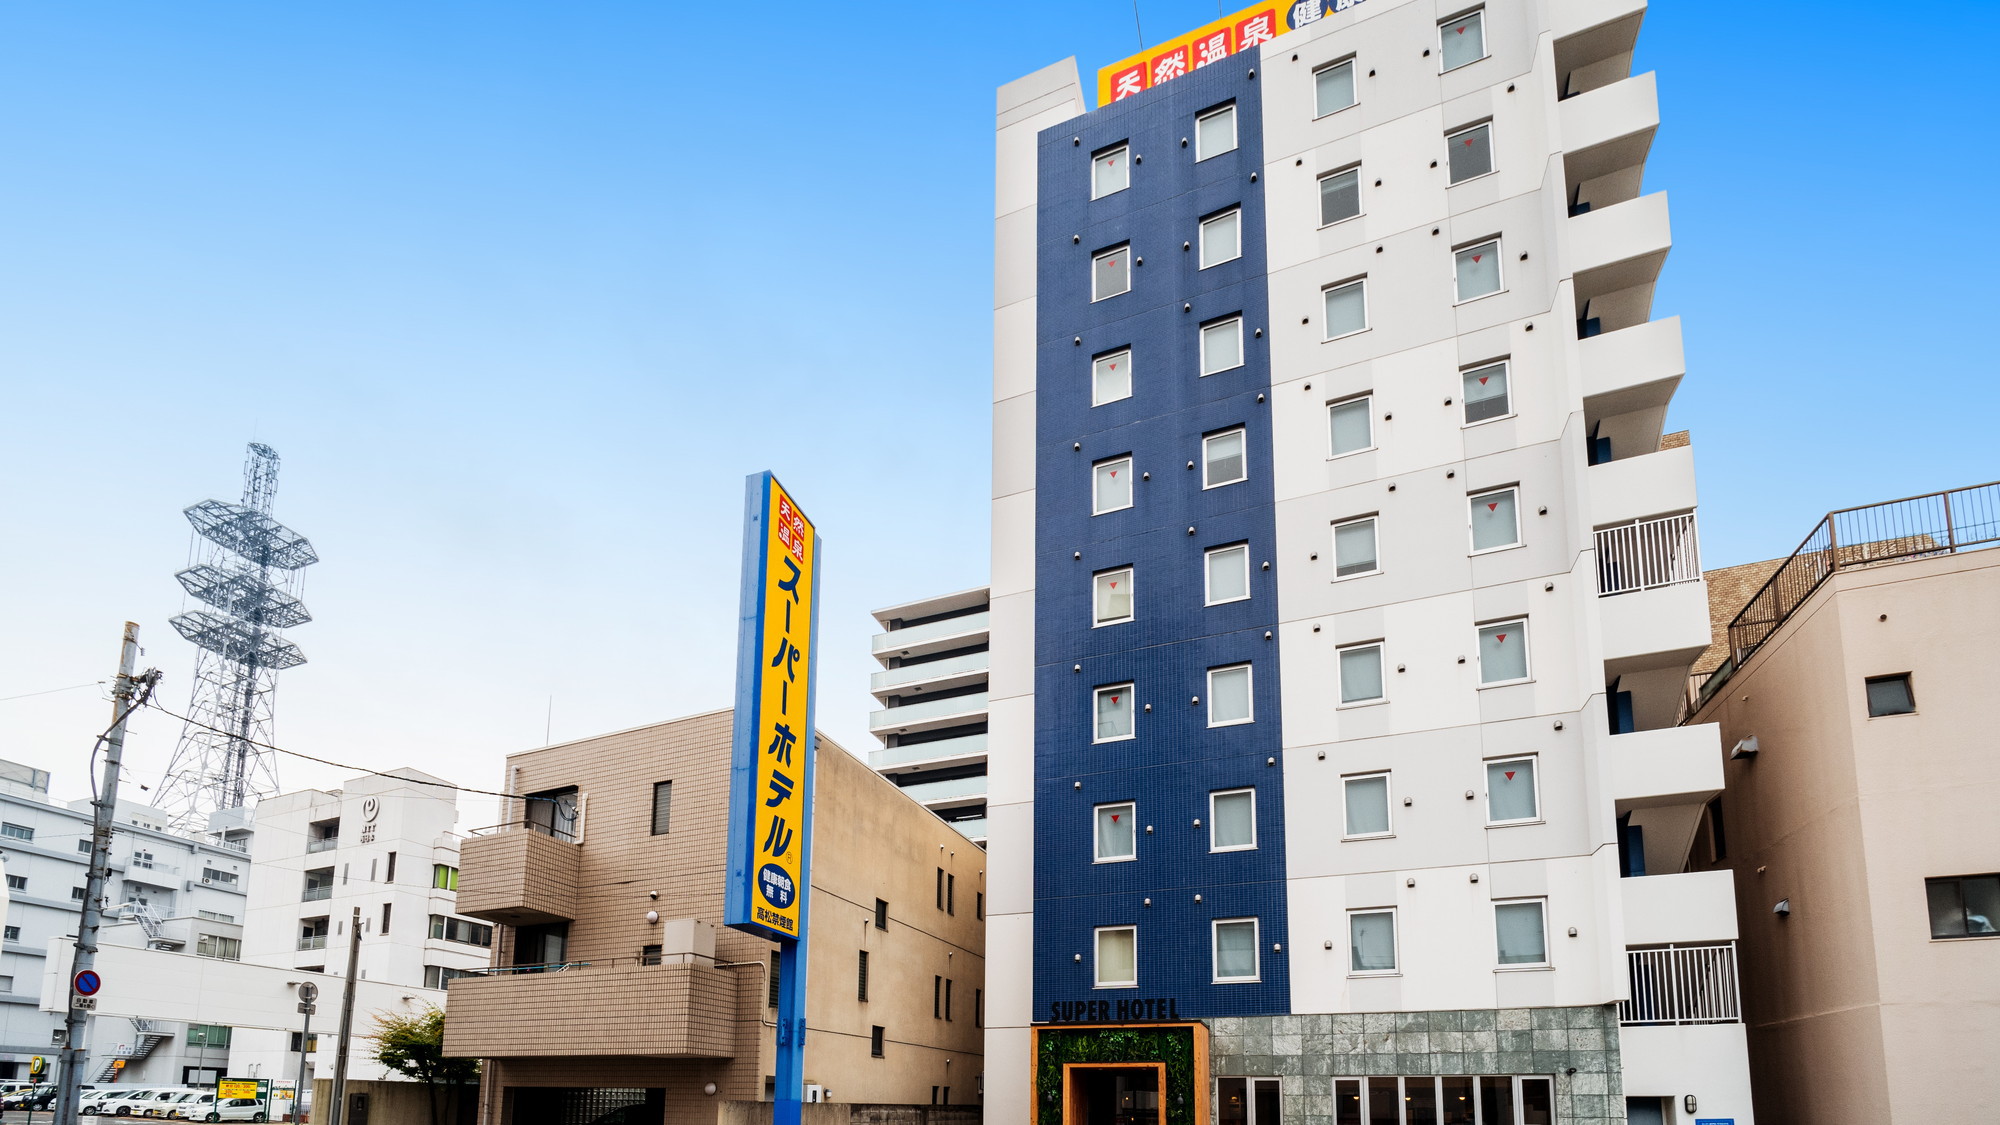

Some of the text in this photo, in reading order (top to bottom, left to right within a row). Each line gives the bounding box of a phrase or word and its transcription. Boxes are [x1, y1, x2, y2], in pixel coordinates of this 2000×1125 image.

[1115, 17, 1274, 101] 天然温泉
[780, 500, 804, 538] 天然
[778, 522, 804, 563] 温泉
[762, 555, 802, 858] スーパーホテル
[1051, 998, 1180, 1021] SUPER HOTEL
